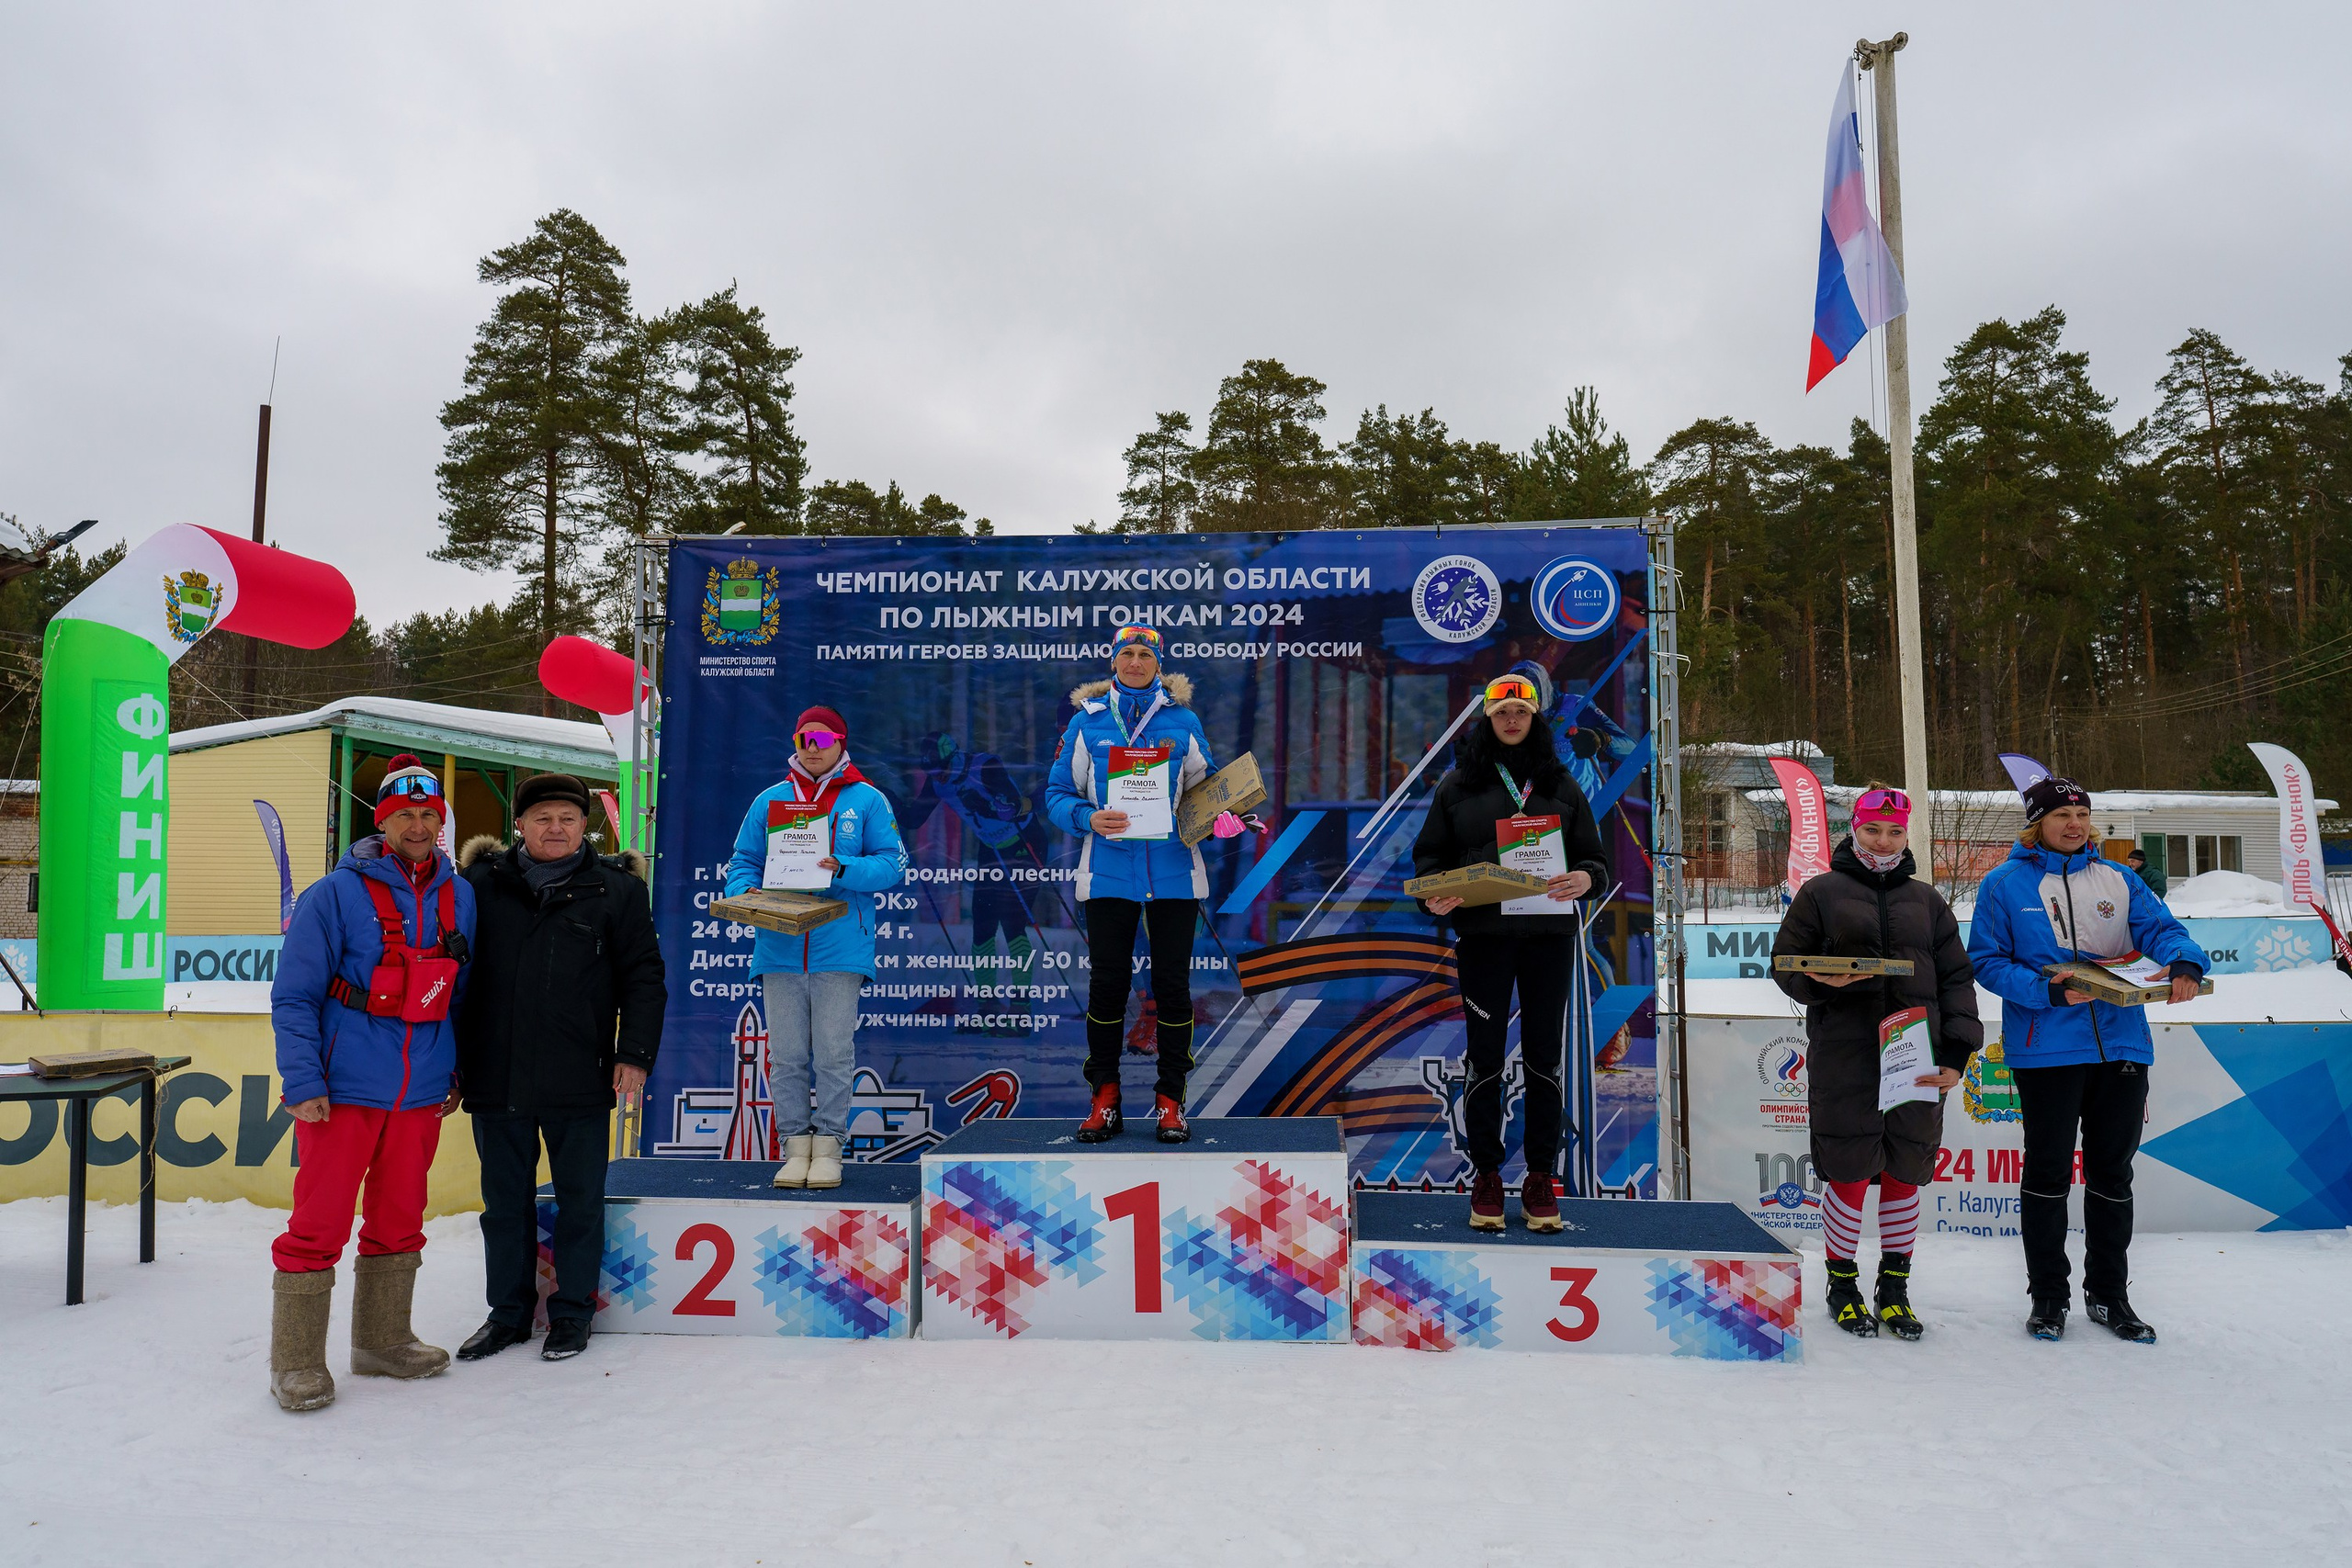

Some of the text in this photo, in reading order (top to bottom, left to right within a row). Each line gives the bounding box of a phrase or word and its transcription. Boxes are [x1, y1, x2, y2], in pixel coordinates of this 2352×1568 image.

[816, 562, 1371, 593] ЧЕМПИОНАТ КАЛУЖСКОЙ ОБЛАСТИ
[1425, 559, 1453, 579] ЛЫЖНЫХ
[1454, 559, 1476, 570] ГОНОК
[1573, 589, 1603, 600] ЦСП
[880, 604, 1305, 628] ПО ЛЫЖНЫМ ГОНКАМ 2024
[1448, 588, 1498, 639] КАЛУЖСКОЙ ОБЛАСТИ
[817, 642, 1363, 660] ПАМЯТИ ГЕРОЕВ ЗАЩИЩАЮ СВОБОДУ РОССИИ
[699, 656, 777, 666] МИНИСТЕРСТВО СПОРТА
[700, 667, 775, 677] КАЛУЖСКОЙ ОБЛАСТИ
[1123, 779, 1157, 787] ГРАМОТА
[102, 693, 167, 980] ФИНИШ
[1515, 850, 1550, 858] ГРАМОТА
[695, 867, 708, 880] г.
[904, 868, 1004, 885] родного
[692, 920, 720, 939] 24
[899, 925, 914, 939] г.
[174, 948, 282, 982] РОССИ
[1042, 951, 1072, 969] 50
[689, 978, 763, 1000] Старт:
[859, 984, 1069, 1002] енщины масстарт
[854, 1012, 1060, 1032] ужчины масстарт
[1885, 1041, 1915, 1058] ГРАМОТА
[1757, 1036, 1809, 1085] ОЛИМПИЙСКИЙ КОМИ
[1774, 1114, 1807, 1124] СТРАНА
[1932, 1147, 1975, 1183] 24
[1937, 1190, 2021, 1219] г. Калуга
[1751, 1211, 1808, 1220] НИСТЕРСТВО
[1793, 1222, 1824, 1230] ФЕДЕР
[1103, 1181, 1162, 1314] 1
[672, 1223, 736, 1316] 2
[1883, 1269, 1910, 1278] FISCHE
[1544, 1267, 1600, 1343] 3
